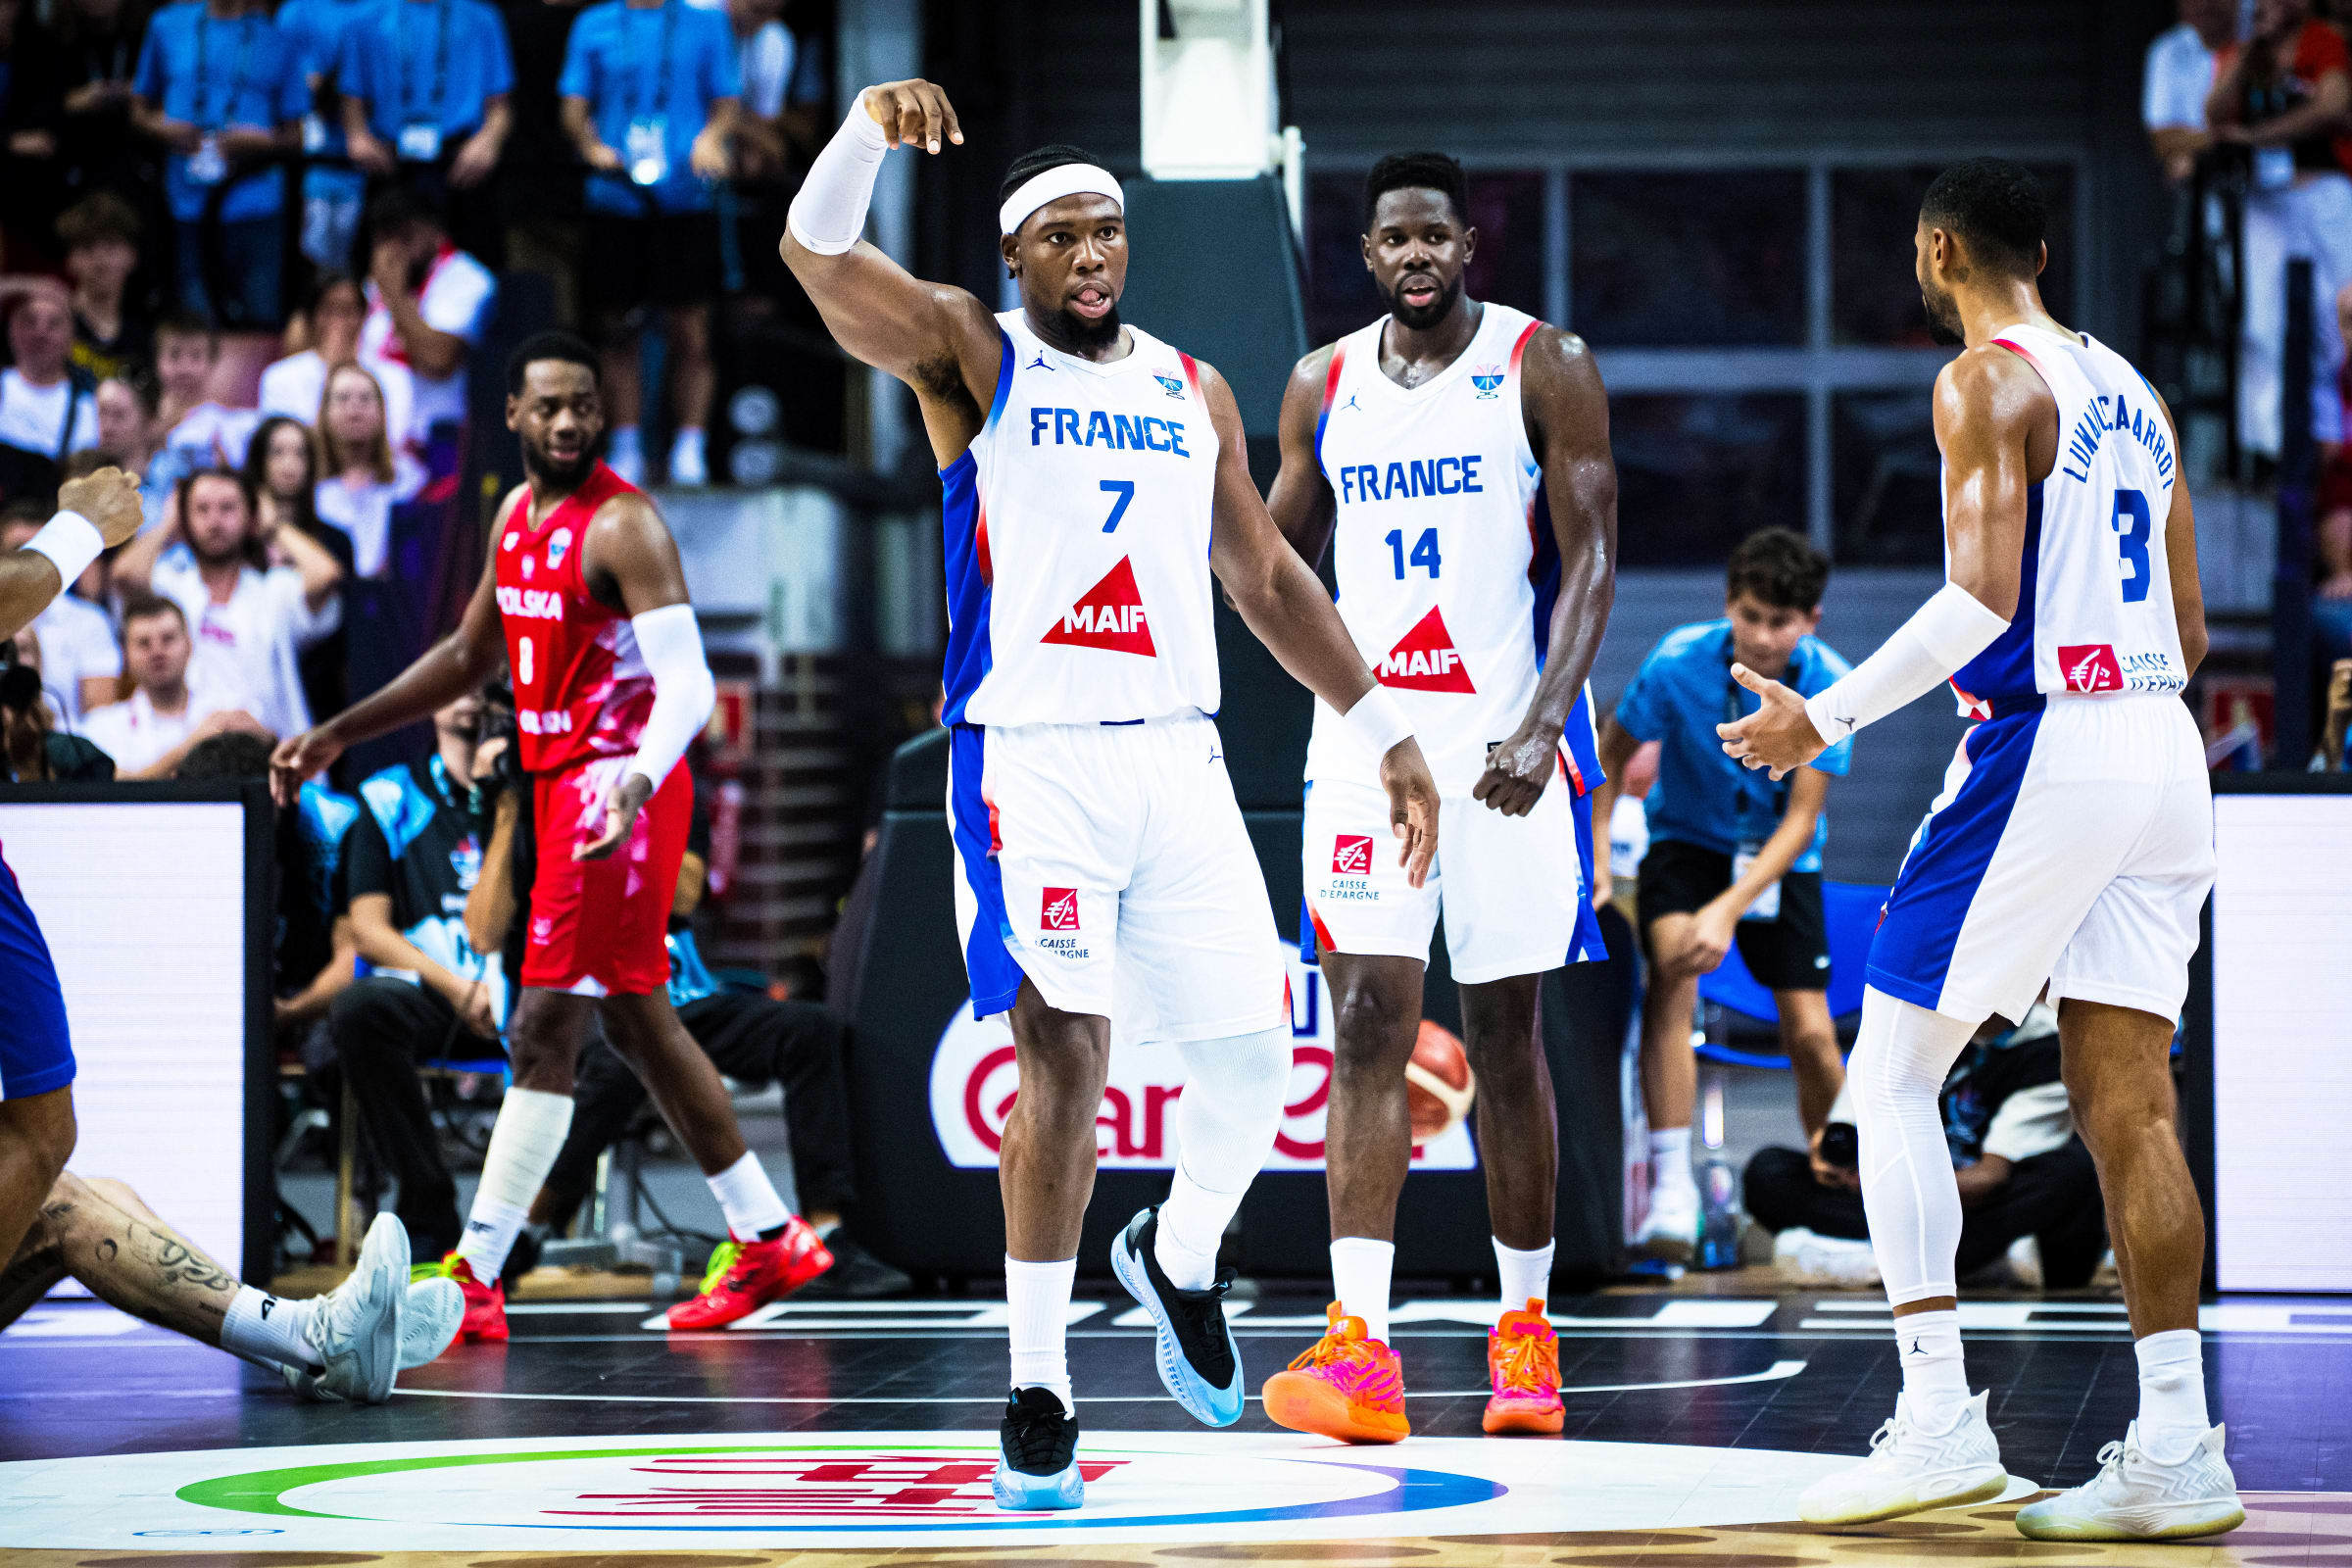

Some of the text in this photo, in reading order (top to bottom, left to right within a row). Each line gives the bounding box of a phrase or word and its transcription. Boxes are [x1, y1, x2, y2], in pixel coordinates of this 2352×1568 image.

[1031, 408, 1190, 458] FRANCE
[1341, 455, 1483, 504] FRANCE
[1100, 480, 1134, 533] 7
[1385, 527, 1442, 580] 14
[2111, 489, 2150, 603] 3
[1063, 605, 1146, 634] MAIF
[1380, 648, 1459, 678] MAIF
[1332, 879, 1368, 890] CAISSE
[1040, 938, 1076, 949] CAISSE
